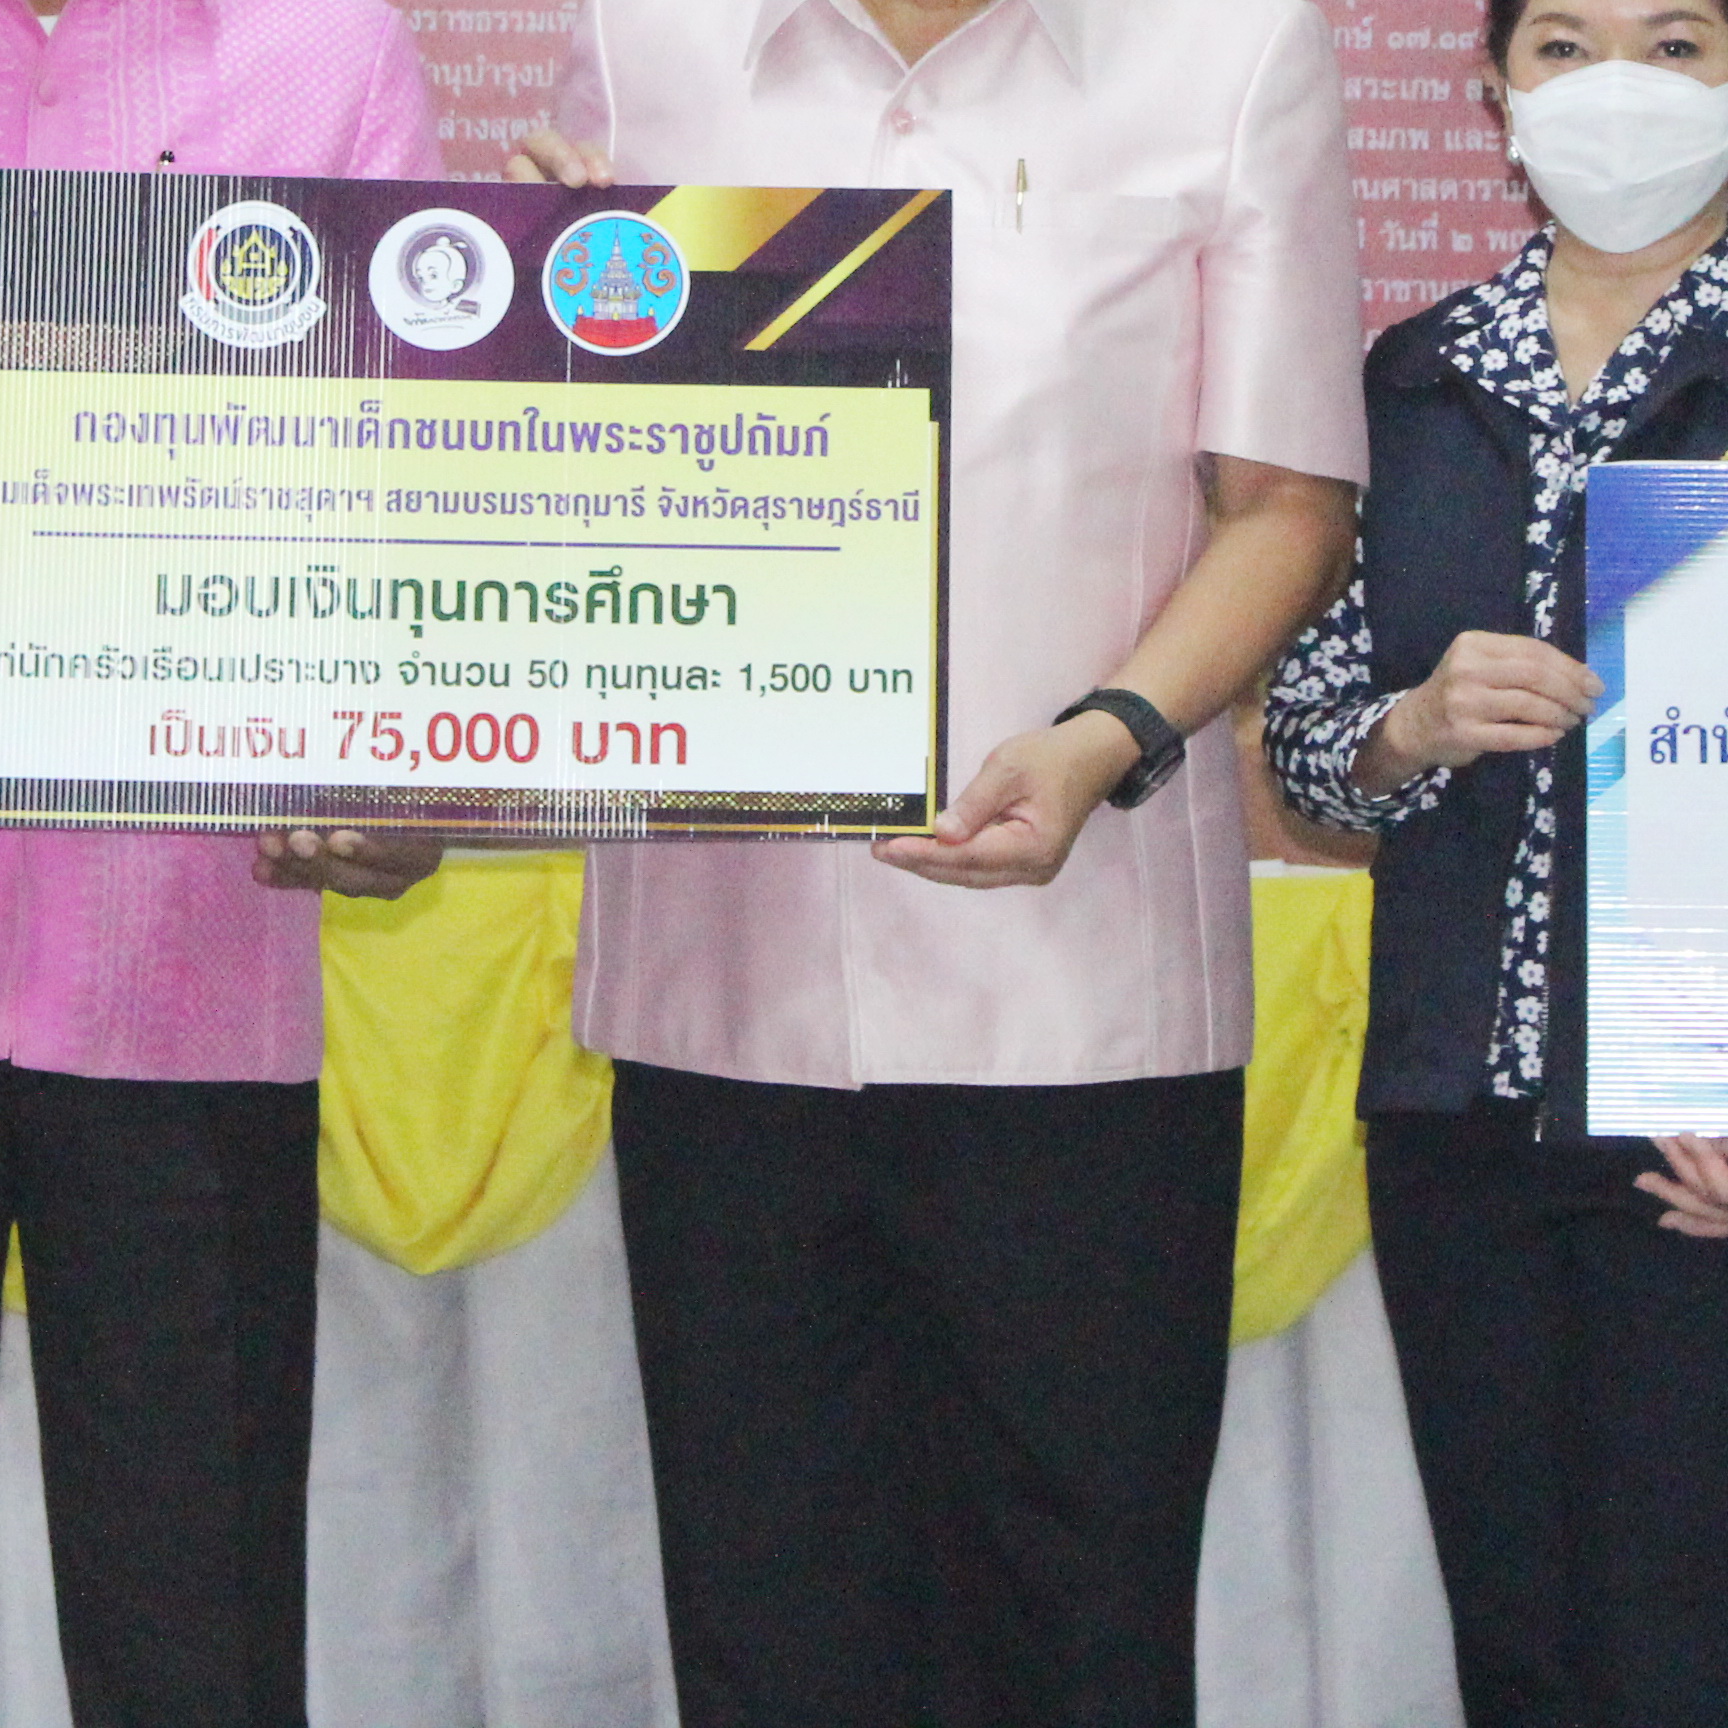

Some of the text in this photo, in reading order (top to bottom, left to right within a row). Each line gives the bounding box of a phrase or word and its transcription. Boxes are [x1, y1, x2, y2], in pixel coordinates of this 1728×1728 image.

[155, 563, 739, 638] มอบเงินทุนการศึกษา
[399, 653, 511, 689] จำนวน
[525, 658, 570, 690] 50
[585, 662, 722, 702] ทุนทุนละ
[739, 663, 833, 700] 1,500
[847, 665, 915, 696] บาท
[332, 712, 541, 774] 75,000
[573, 715, 689, 768] บาท
